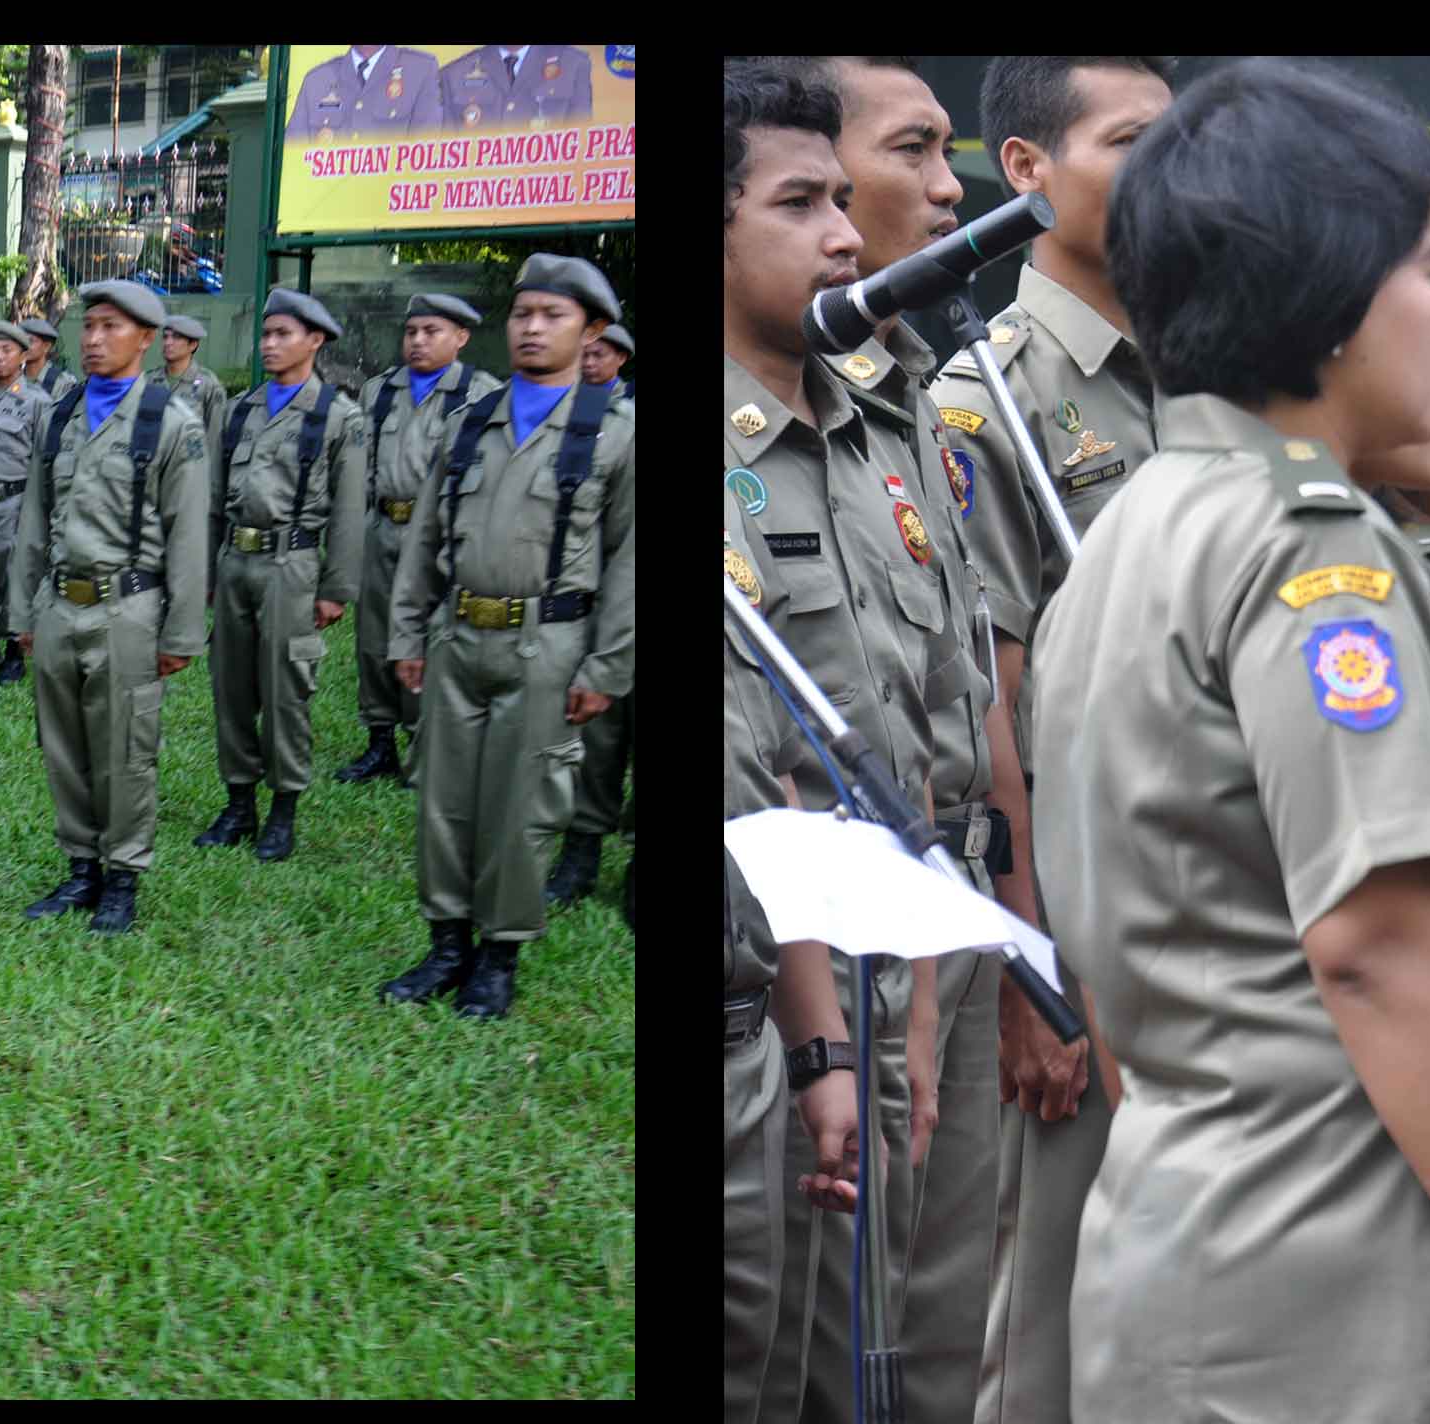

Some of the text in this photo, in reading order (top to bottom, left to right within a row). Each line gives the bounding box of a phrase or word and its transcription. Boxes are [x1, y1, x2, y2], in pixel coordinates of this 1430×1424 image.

[395, 140, 470, 172] POLISI
[476, 130, 579, 168] PAMONG
[388, 169, 635, 212] SIAP MENGAWAL PEL
